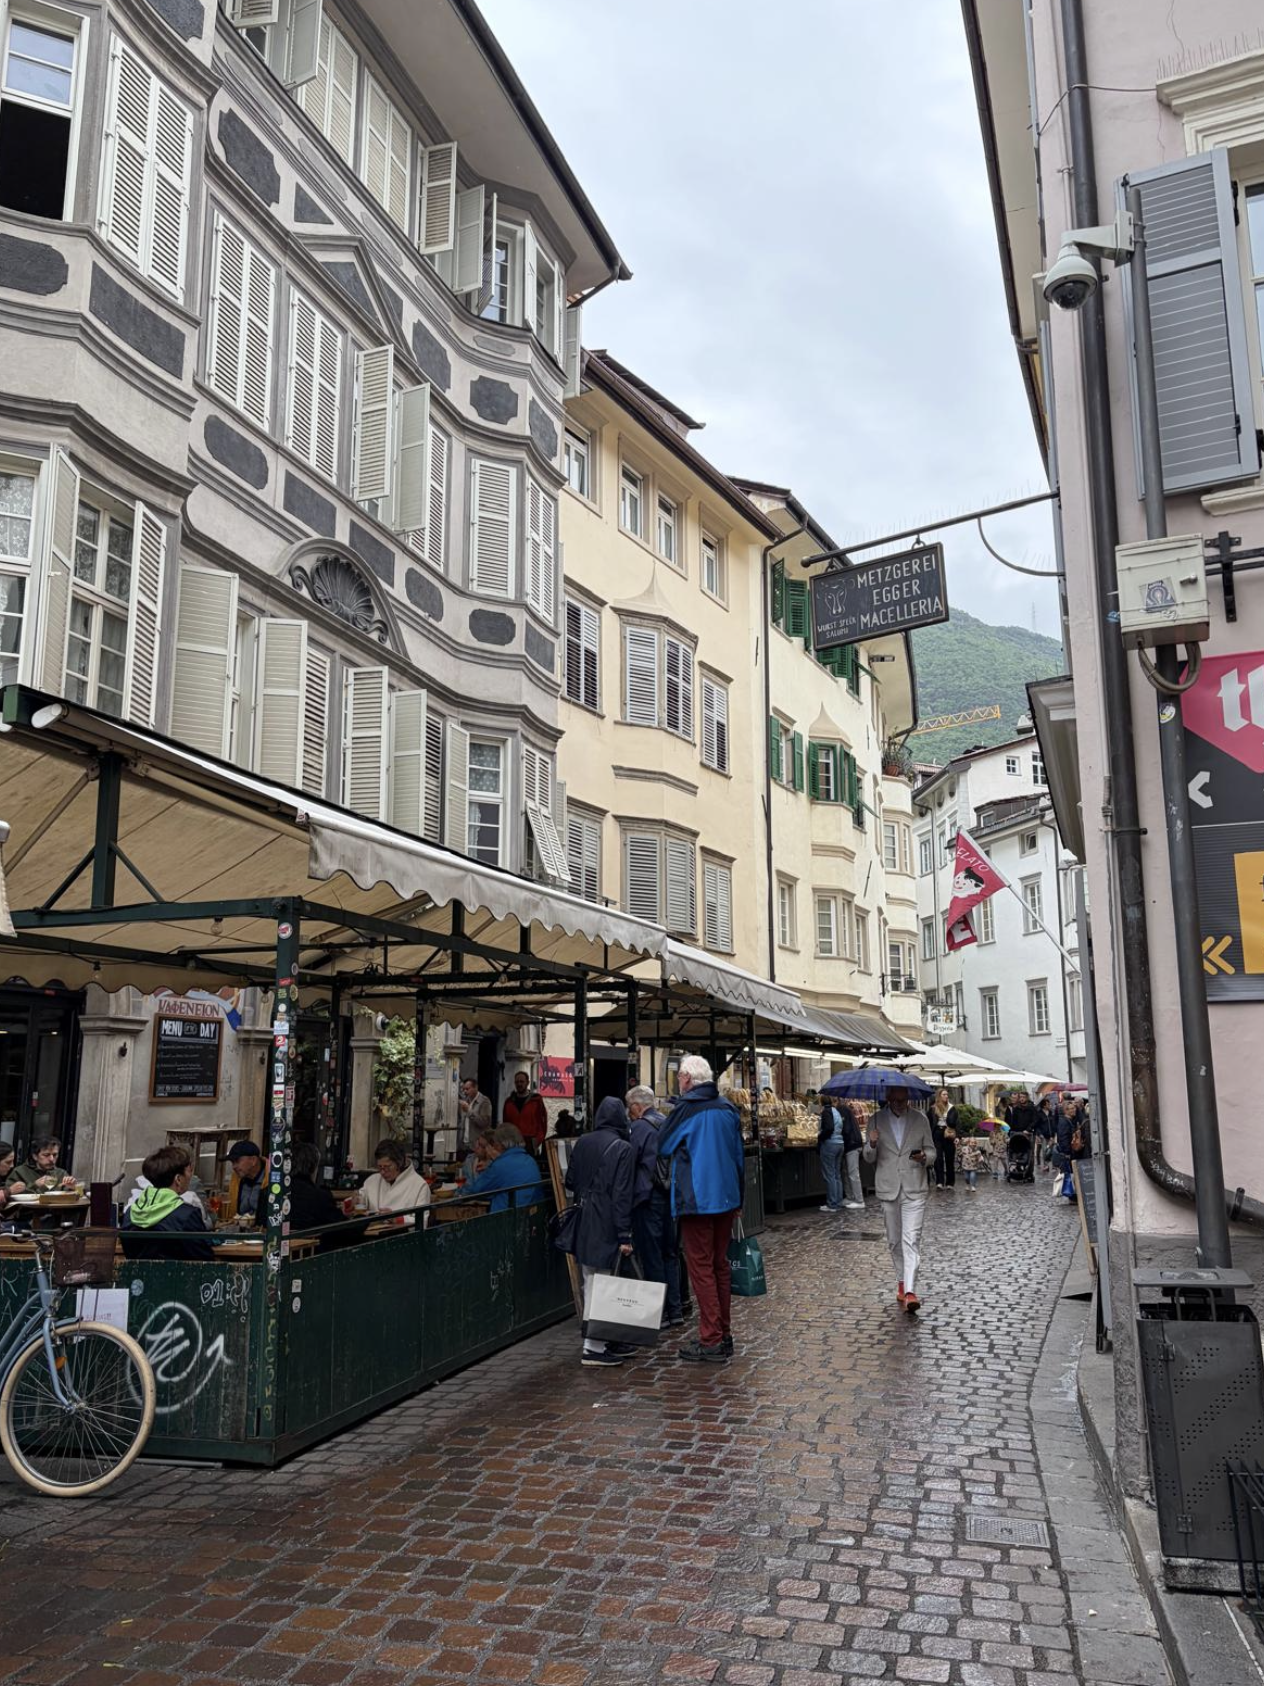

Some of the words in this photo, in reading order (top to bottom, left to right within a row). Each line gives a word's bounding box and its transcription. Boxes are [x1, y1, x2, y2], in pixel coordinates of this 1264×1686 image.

[857, 554, 936, 588] METZGEREI
[872, 579, 921, 606] EGGER
[859, 595, 944, 630] MACELLERIA
[161, 1019, 183, 1037] MENU
[199, 1021, 216, 1038] DAY
